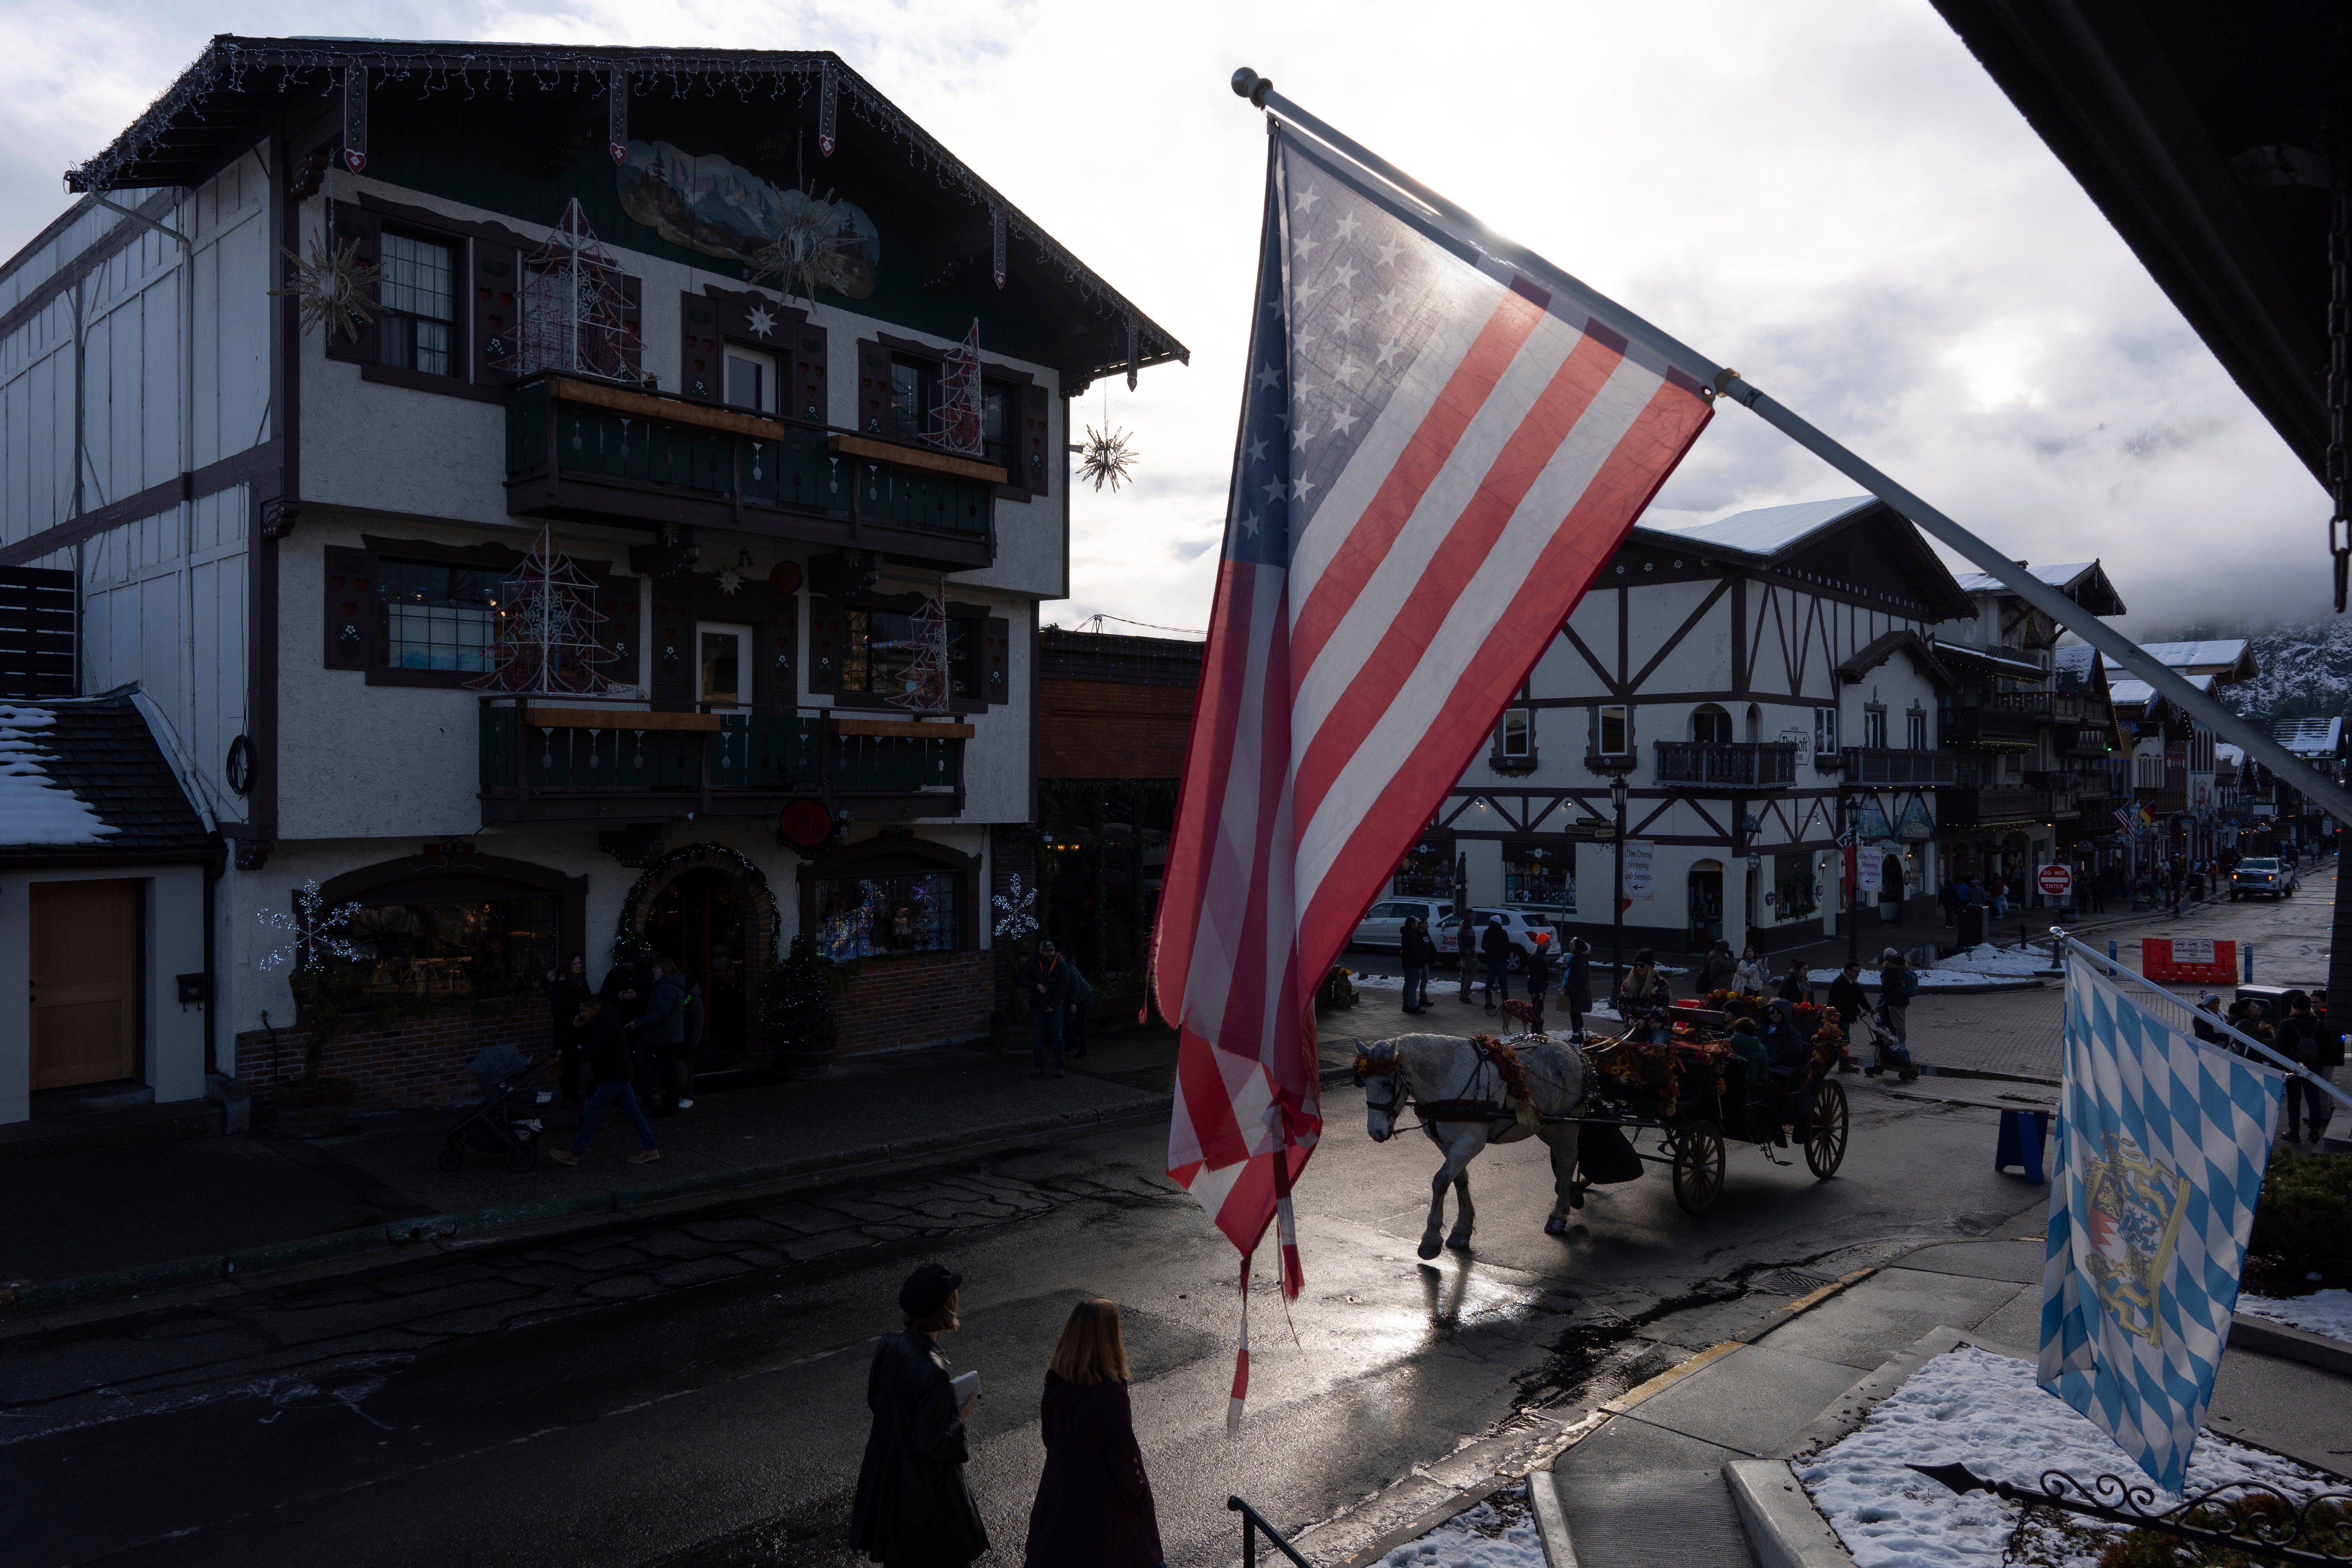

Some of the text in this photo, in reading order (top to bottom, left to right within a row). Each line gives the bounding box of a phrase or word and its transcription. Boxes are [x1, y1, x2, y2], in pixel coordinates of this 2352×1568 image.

[756, 137, 771, 153] 1985
[789, 806, 810, 822] Kris
[1624, 849, 1637, 858] More
[1628, 860, 1649, 871] Shopping
